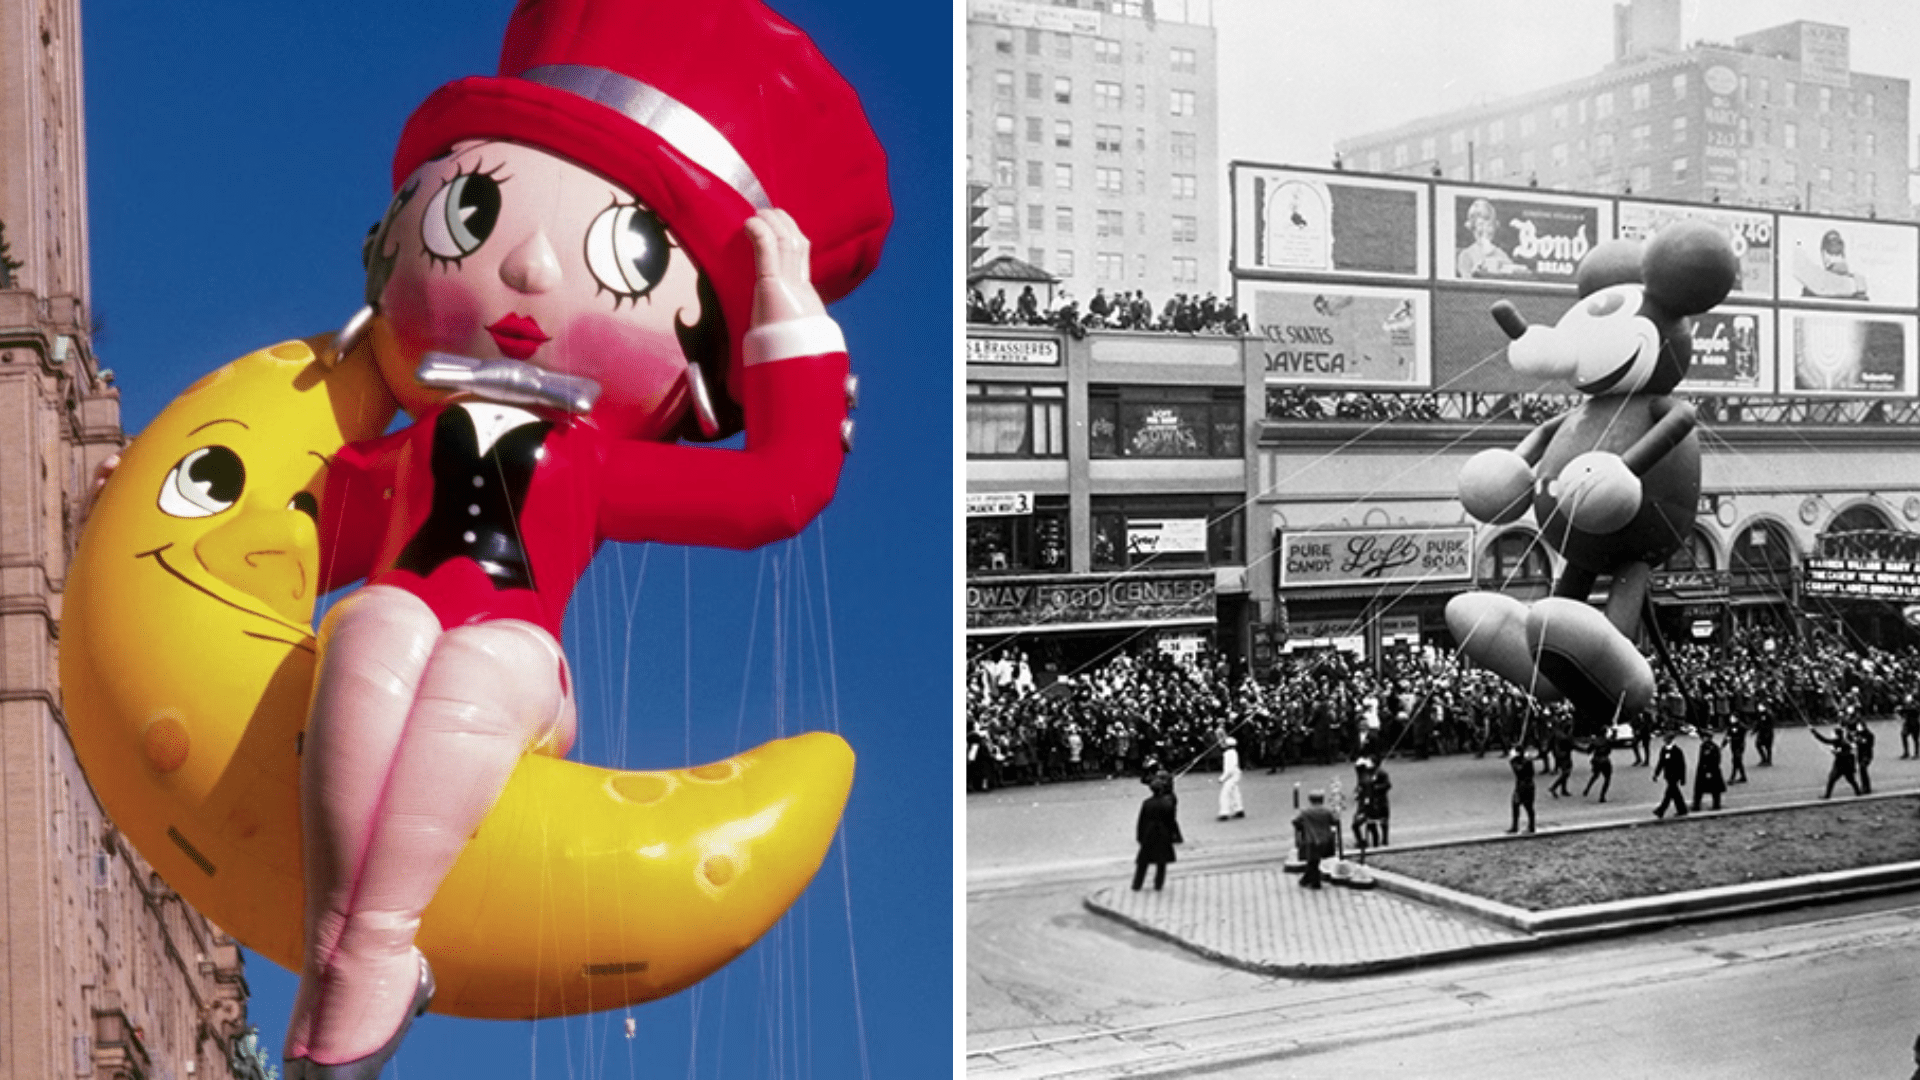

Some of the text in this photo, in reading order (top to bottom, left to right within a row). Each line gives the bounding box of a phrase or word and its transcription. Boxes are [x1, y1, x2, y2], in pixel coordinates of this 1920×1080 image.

[1509, 218, 1588, 261] Bond
[1537, 260, 1573, 275] BREAD
[1290, 543, 1332, 557] PURE
[1340, 534, 1420, 578] Loft
